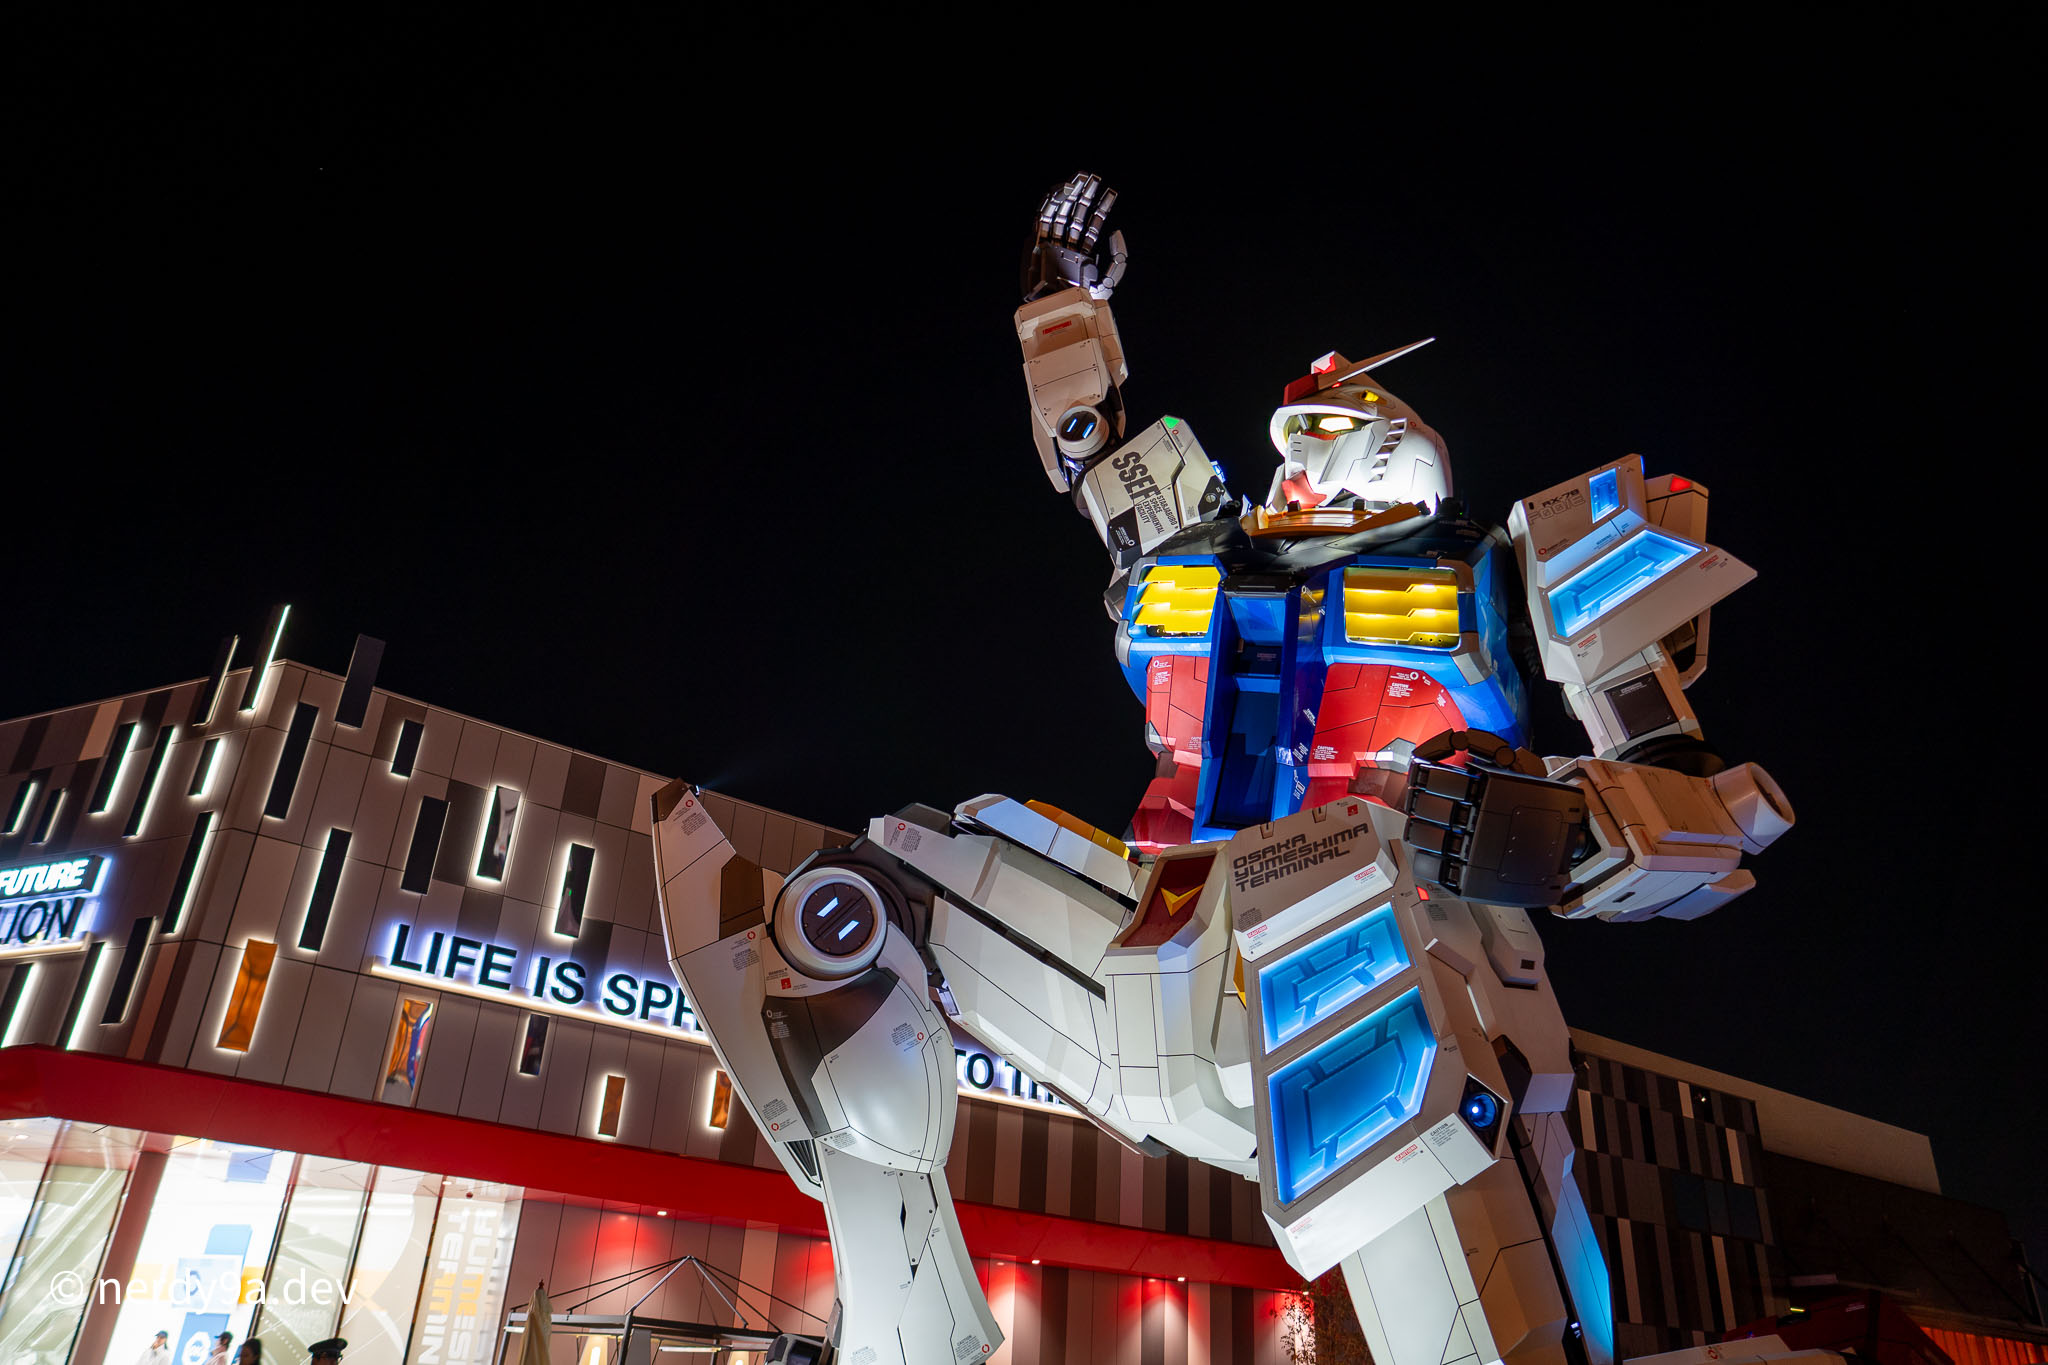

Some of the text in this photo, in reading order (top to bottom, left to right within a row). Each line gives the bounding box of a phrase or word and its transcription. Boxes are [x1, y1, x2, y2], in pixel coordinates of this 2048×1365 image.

[1111, 451, 1162, 502] SSEF
[1233, 833, 1306, 870] OSAKA
[1234, 823, 1369, 882] YUMESHIMA
[1235, 847, 1350, 892] TERMINAL
[0, 858, 90, 896] FUTURE
[0, 896, 87, 945] ION
[390, 923, 517, 991] LIFE
[533, 956, 586, 1005] IS
[1430, 1122, 1449, 1137] CAUTION
